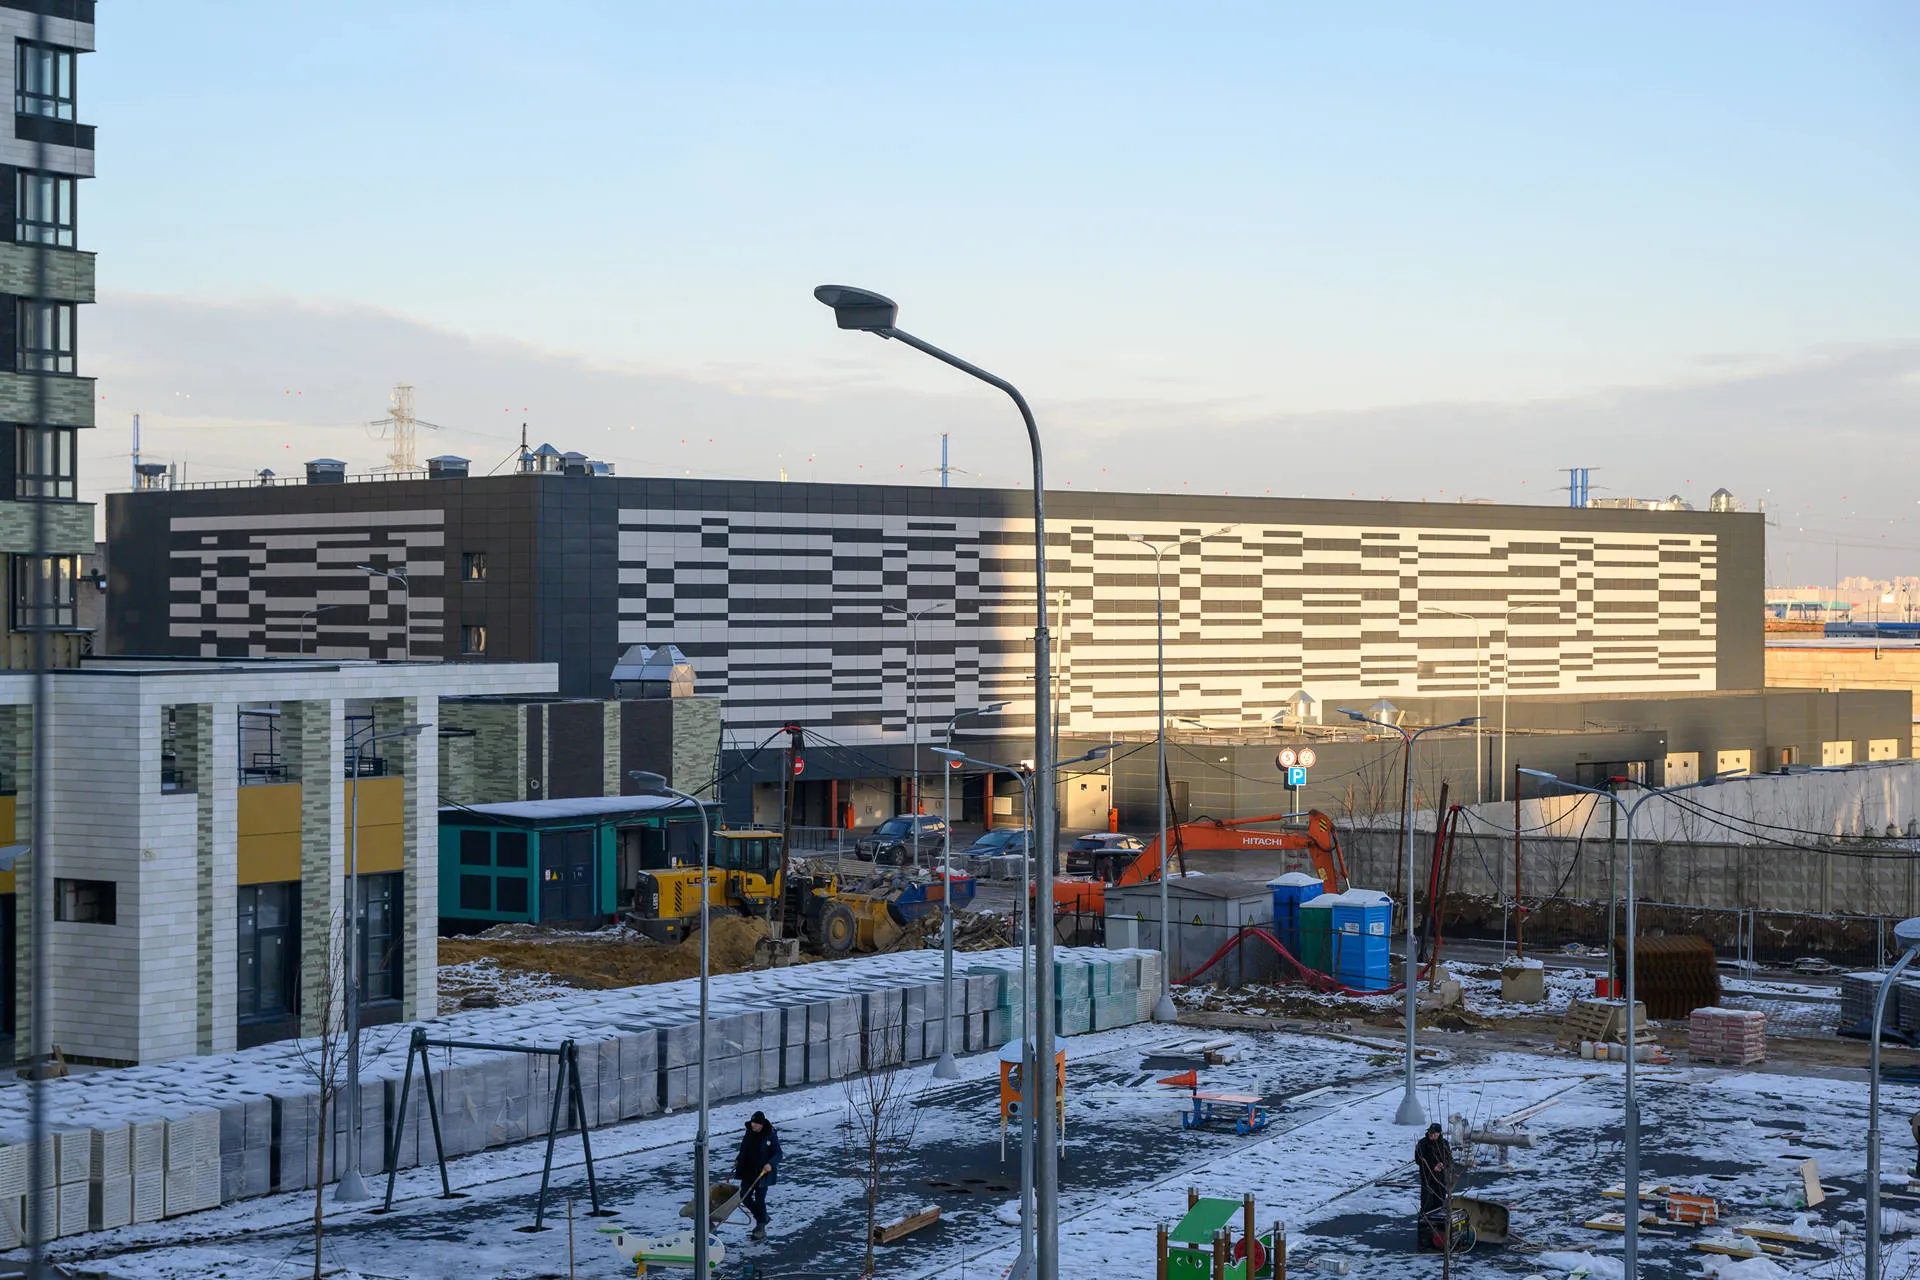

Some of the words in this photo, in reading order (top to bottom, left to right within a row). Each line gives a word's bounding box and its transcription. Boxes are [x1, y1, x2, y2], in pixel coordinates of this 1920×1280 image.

[1293, 769, 1303, 783] P
[1242, 837, 1282, 846] HITACHI
[686, 876, 718, 884] LGE
